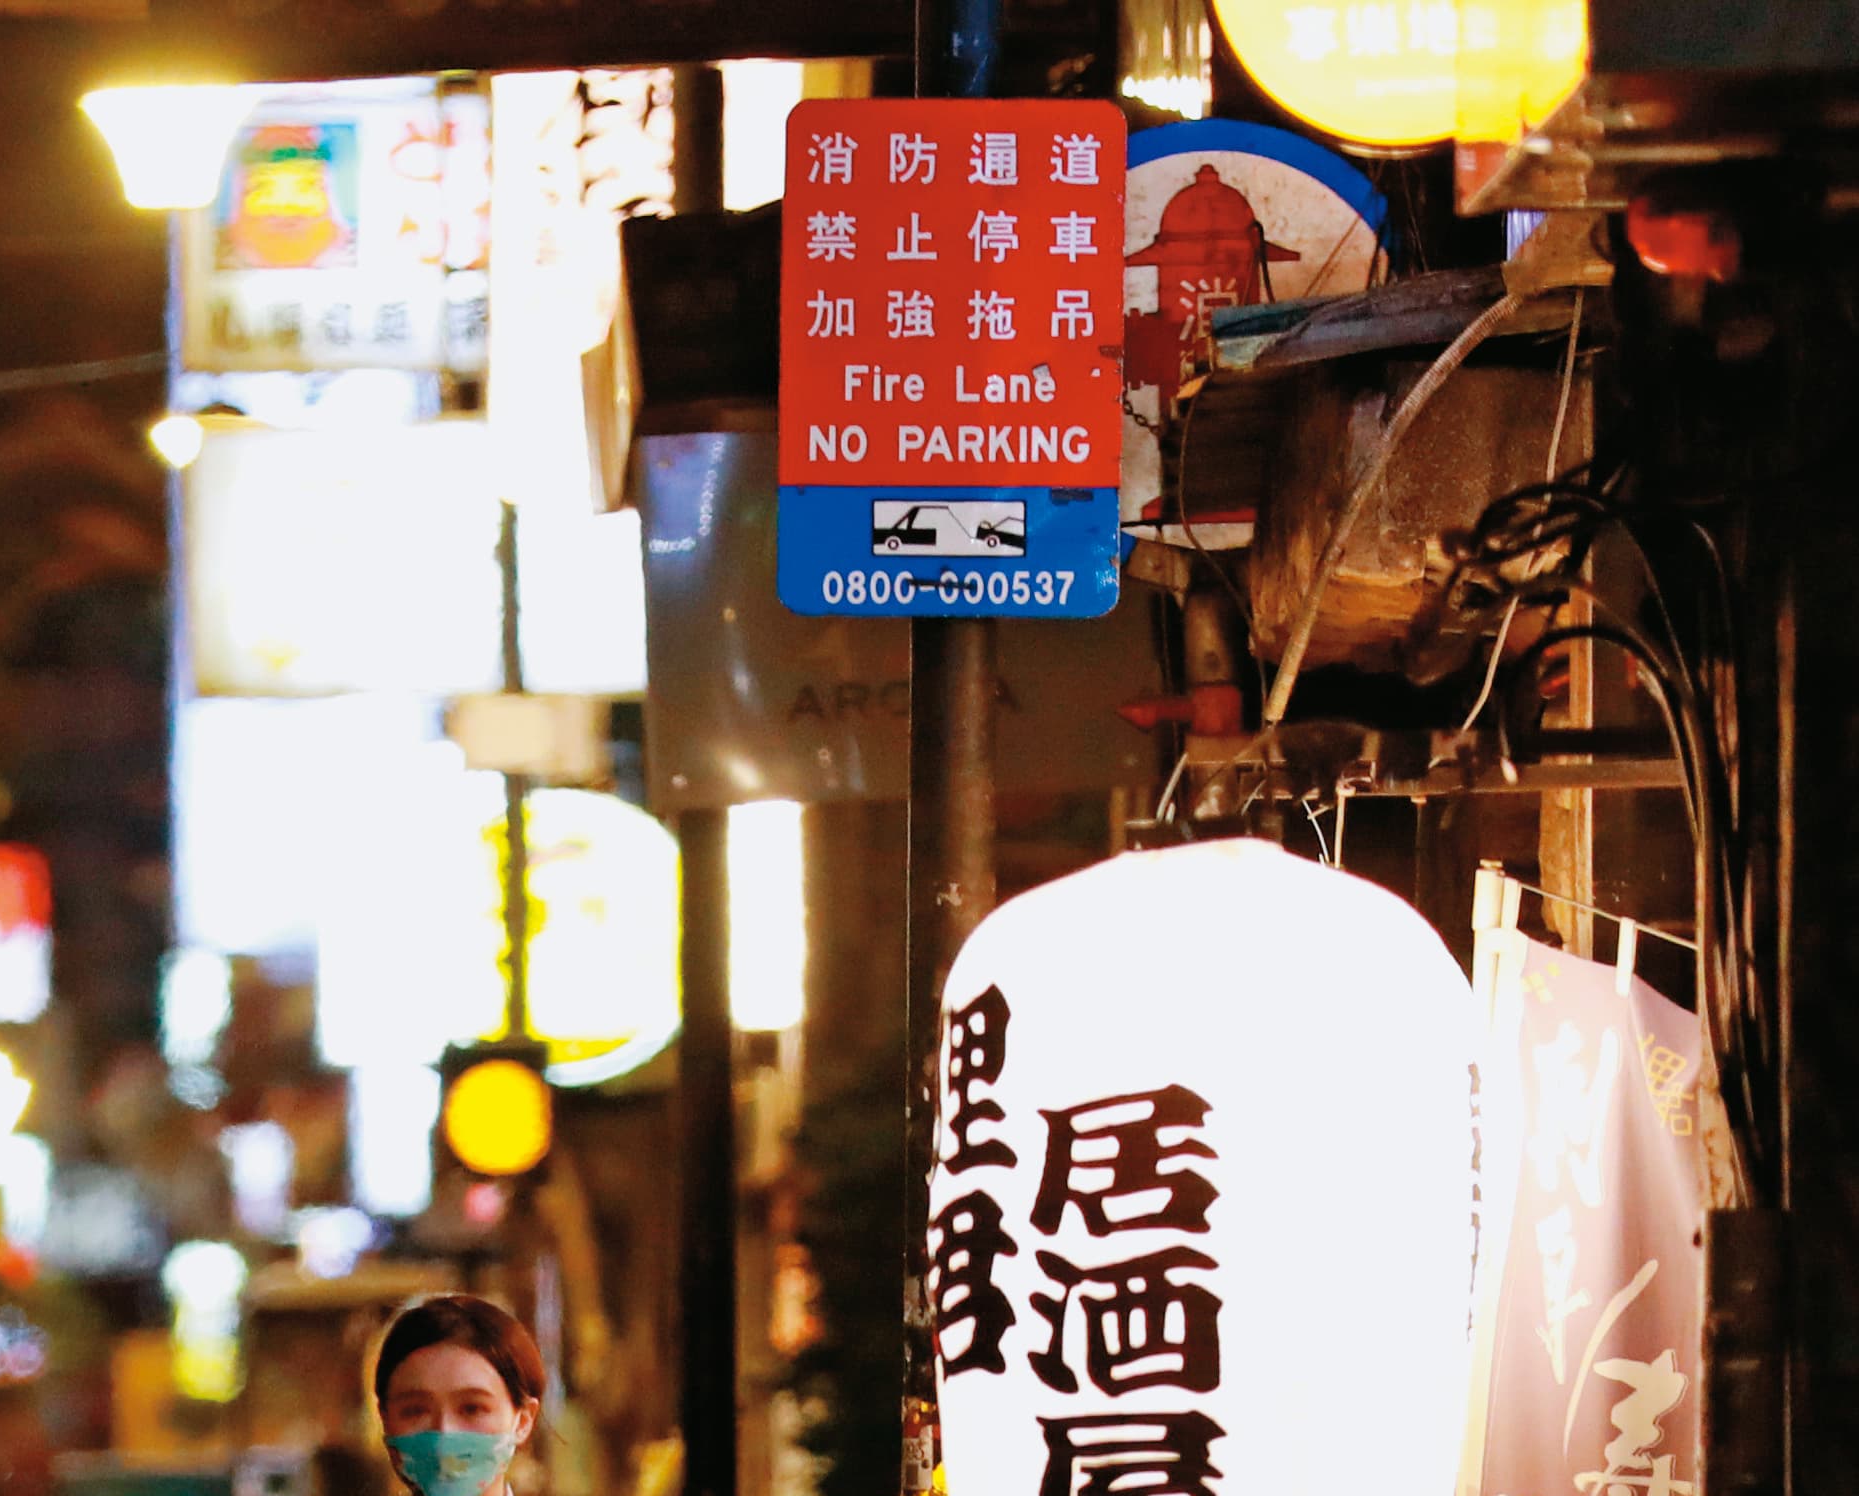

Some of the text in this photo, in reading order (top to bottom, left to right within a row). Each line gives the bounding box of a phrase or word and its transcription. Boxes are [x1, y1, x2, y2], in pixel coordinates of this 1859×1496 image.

[807, 132, 1101, 187] 消防通道
[806, 211, 1099, 262] 禁止停車
[806, 290, 1096, 341] 加強拖吊
[844, 363, 1057, 403] Fire Lane
[808, 424, 1091, 464] NO PARKING
[822, 570, 1075, 606] 0800-000537
